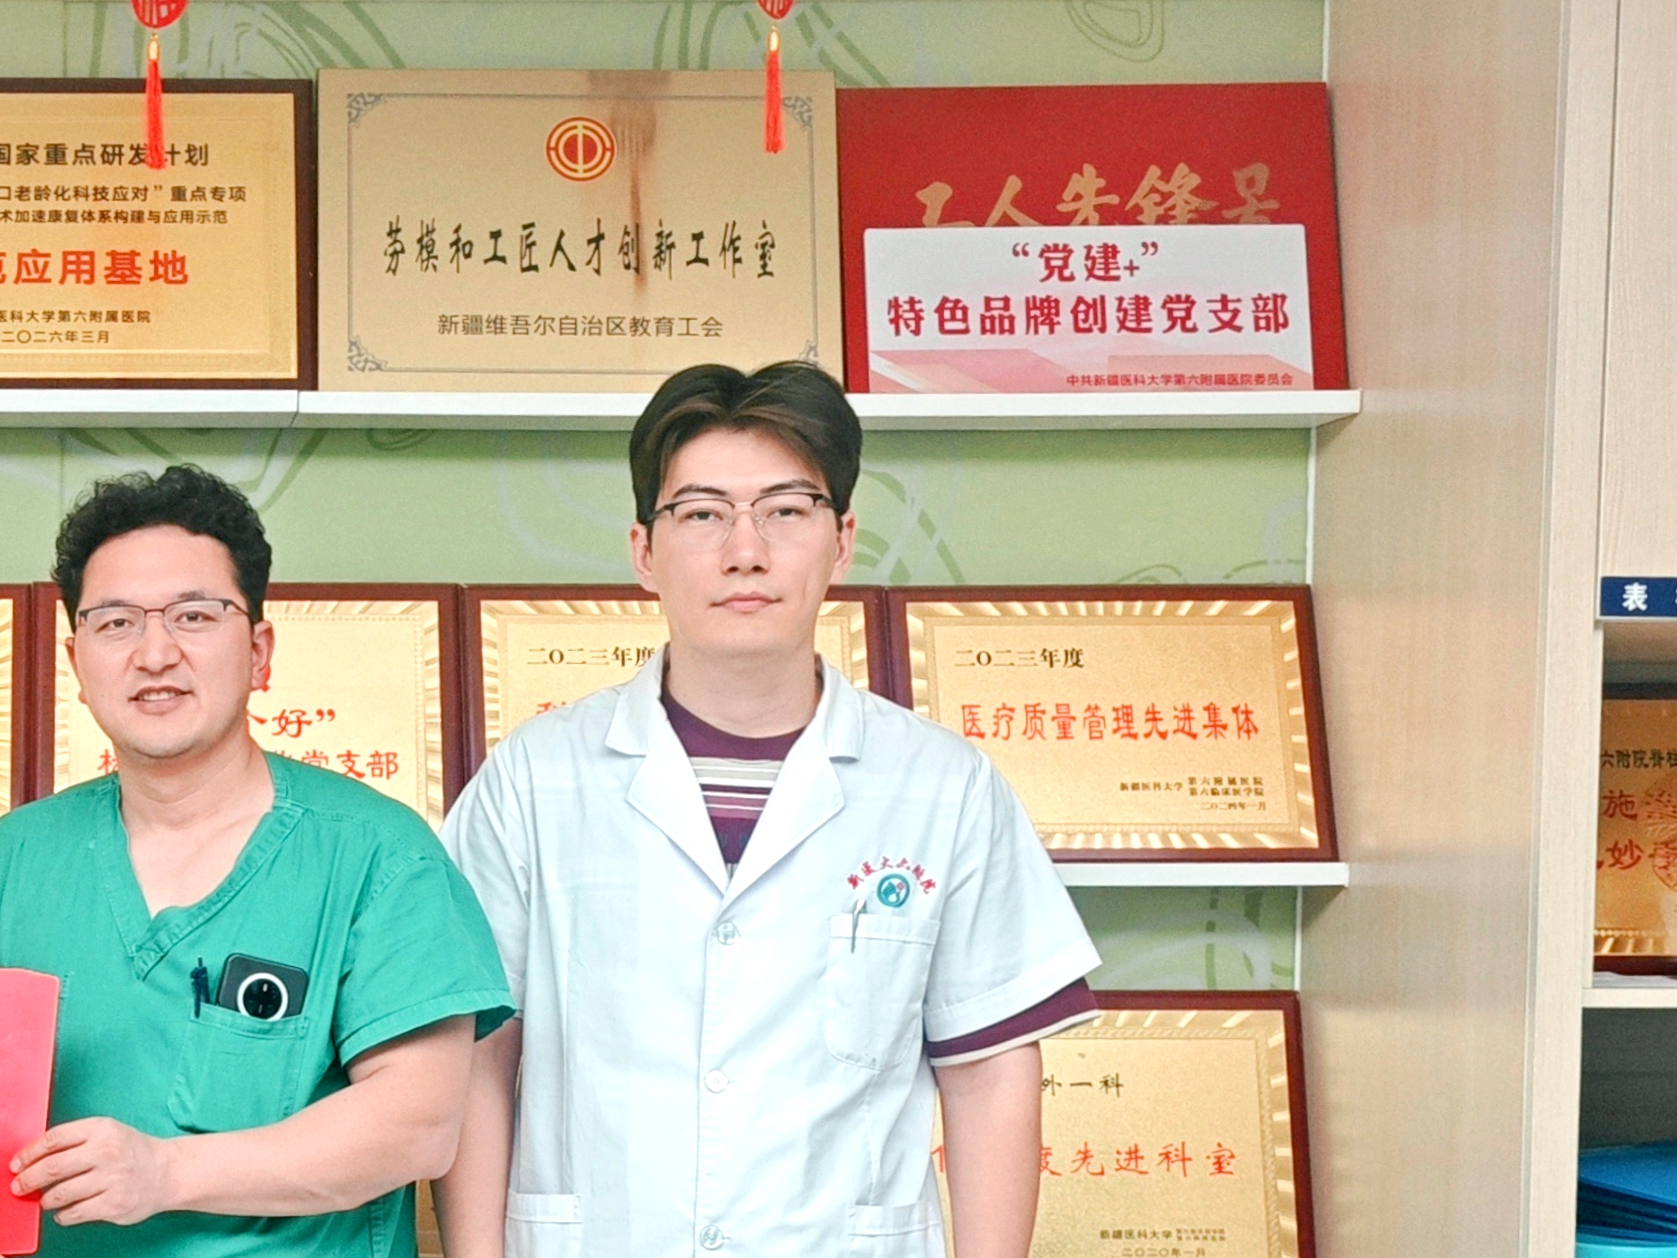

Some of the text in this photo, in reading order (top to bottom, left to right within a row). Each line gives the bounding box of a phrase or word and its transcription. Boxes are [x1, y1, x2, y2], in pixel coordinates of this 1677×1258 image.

[382, 214, 777, 281] 劳模和工匠人才创新工作室
[436, 312, 724, 338] 新疆维吾尔自治区教育工会
[886, 292, 1291, 337] 特色品牌创建党支部
[1065, 372, 1295, 387] 中共新疆医科大学第六附属医院委员会
[960, 700, 1260, 742] 医疗质量管理先进集体
